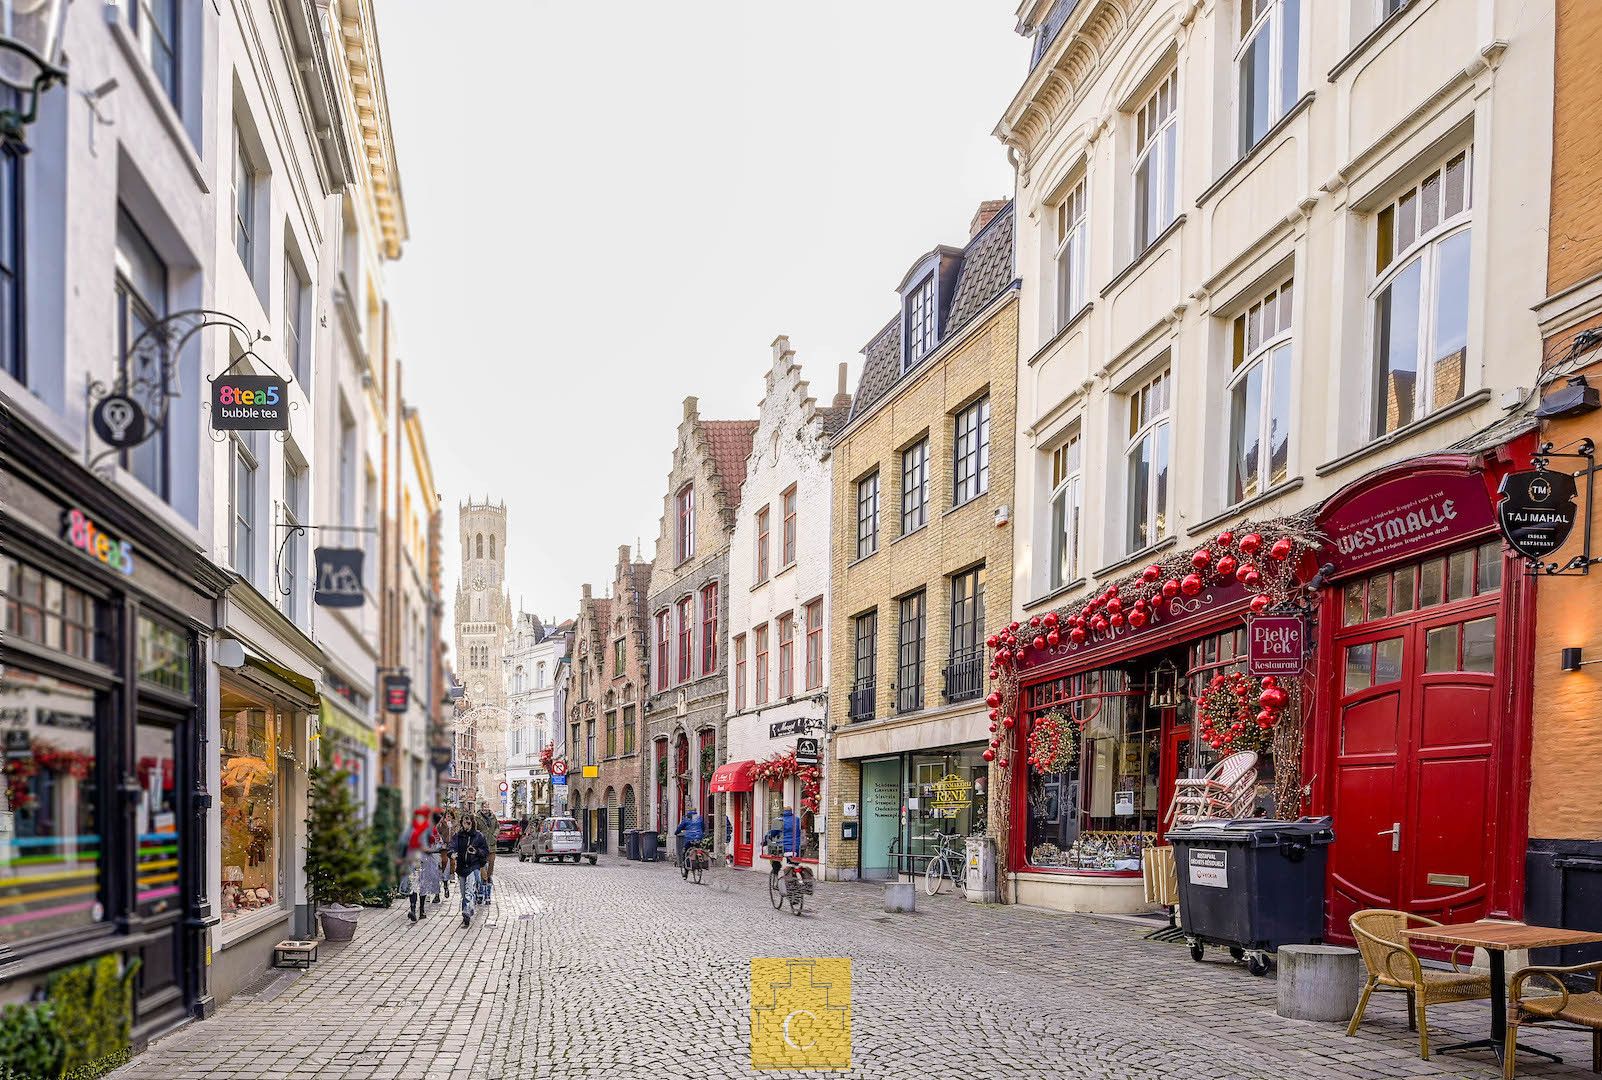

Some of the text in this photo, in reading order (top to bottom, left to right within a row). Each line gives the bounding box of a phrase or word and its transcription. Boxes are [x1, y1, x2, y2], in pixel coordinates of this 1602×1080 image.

[220, 385, 280, 405] 8tea5
[221, 408, 278, 418] bubble tea
[1532, 486, 1547, 494] TM
[1507, 512, 1569, 523] TAJ MAHAL
[1336, 498, 1458, 555] WESTMALLE
[69, 508, 135, 576] 8tea5
[1254, 627, 1299, 643] Pietje
[1262, 638, 1293, 654] Pek
[1255, 660, 1298, 669] Restaurant
